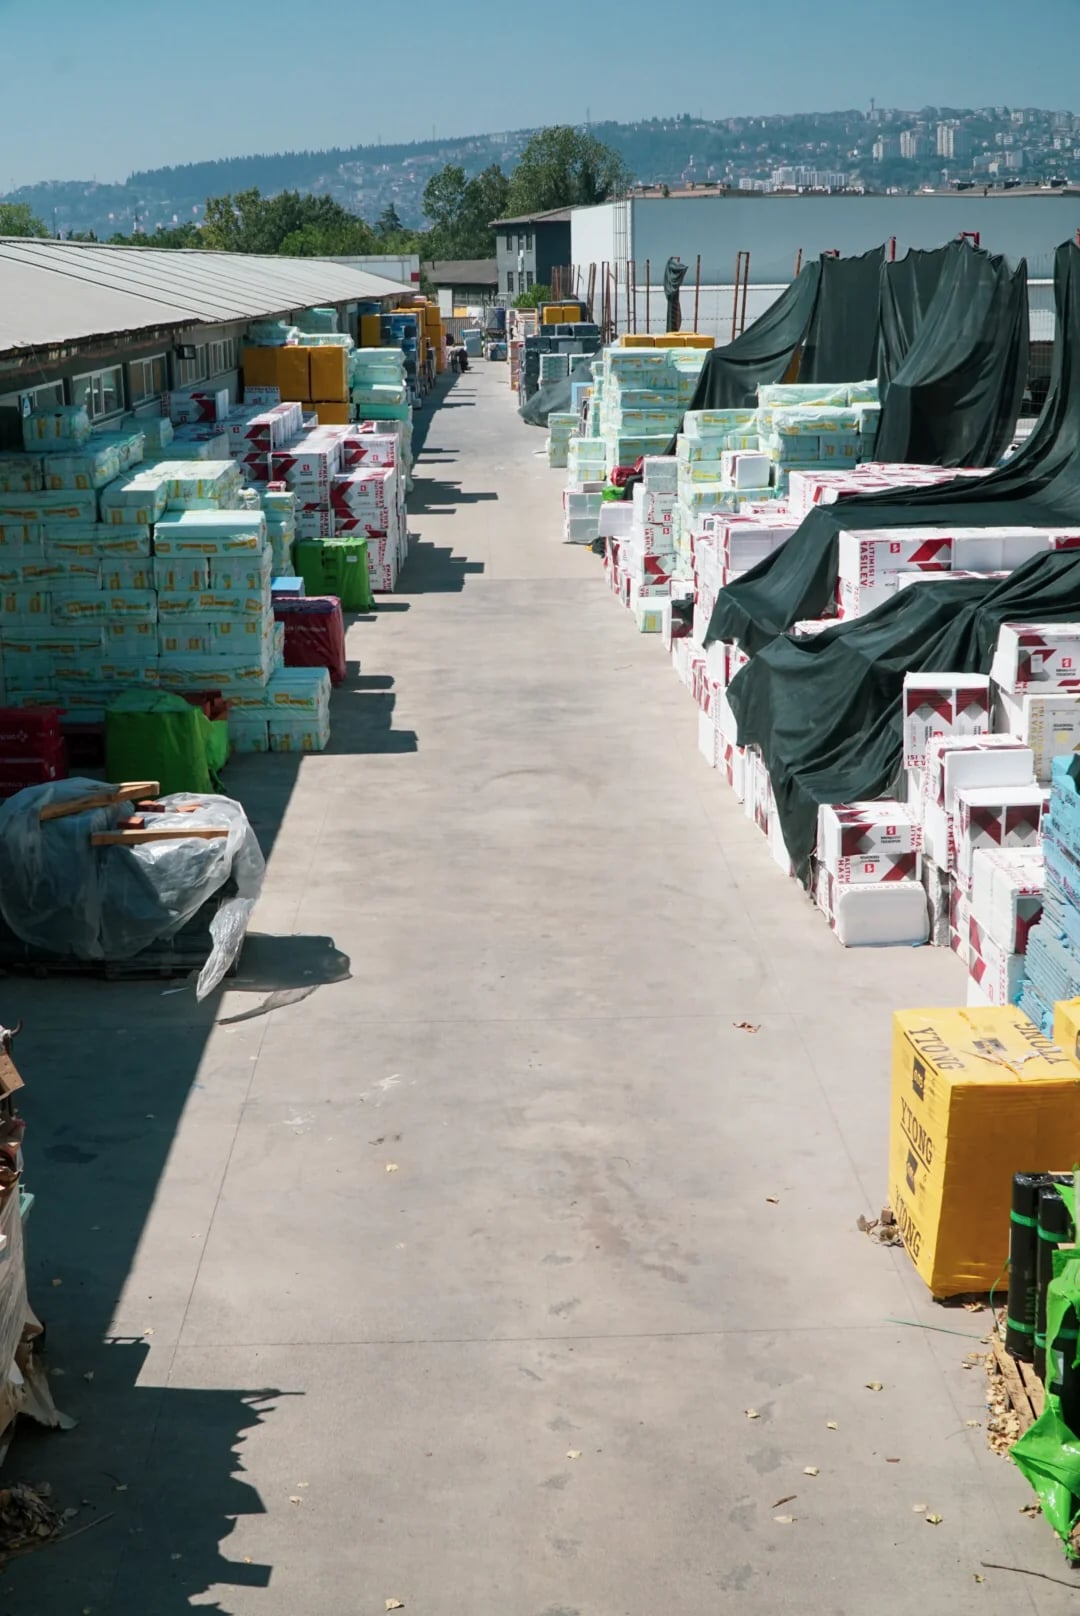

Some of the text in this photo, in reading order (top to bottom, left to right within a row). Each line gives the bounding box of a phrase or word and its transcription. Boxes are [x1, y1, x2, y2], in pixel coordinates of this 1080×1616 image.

[908, 1026, 965, 1070] YTONG
[901, 1095, 933, 1165] YTONG
[896, 1184, 922, 1258] YTONG
